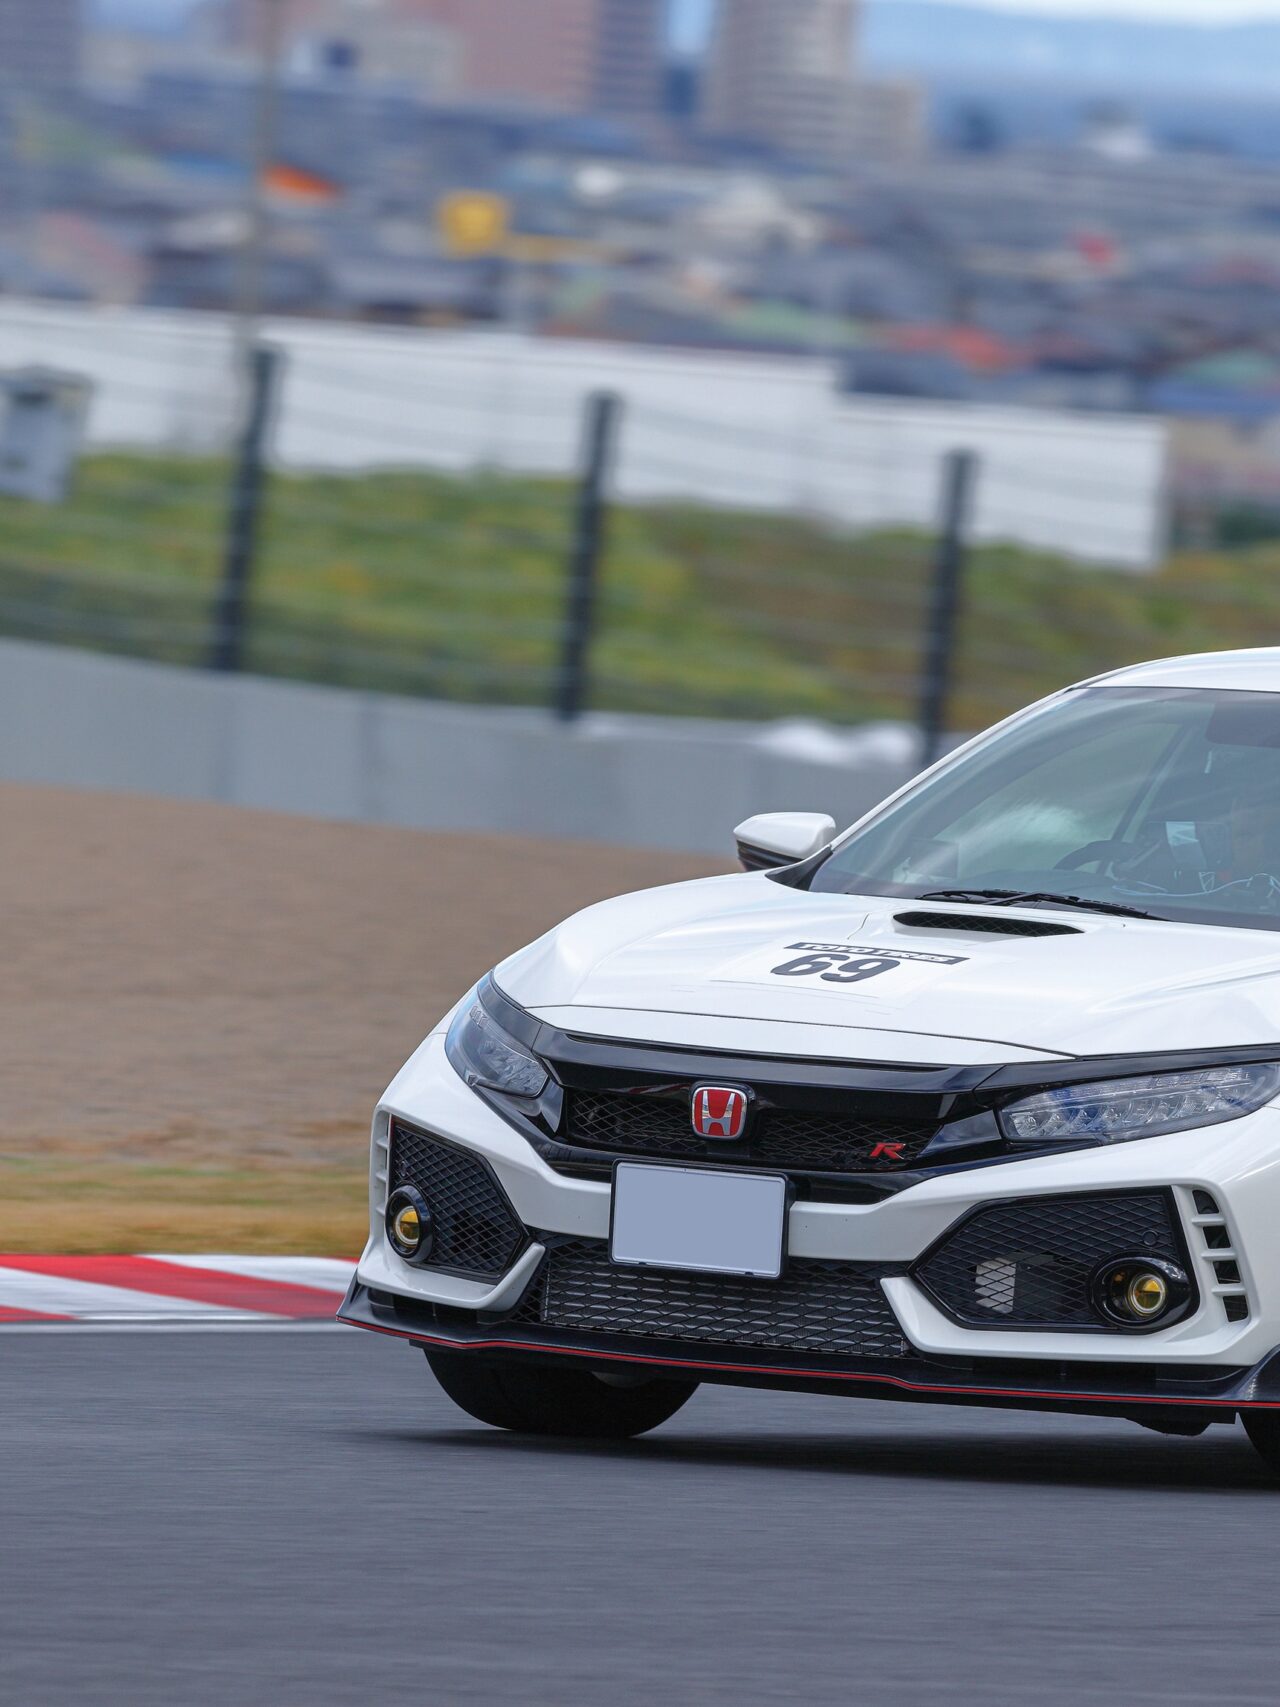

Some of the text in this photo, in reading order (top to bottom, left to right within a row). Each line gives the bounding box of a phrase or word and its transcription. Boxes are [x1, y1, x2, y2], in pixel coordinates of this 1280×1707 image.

[799, 943, 956, 963] TOYO TIRES
[771, 953, 900, 982] 69
[870, 1142, 905, 1159] R
